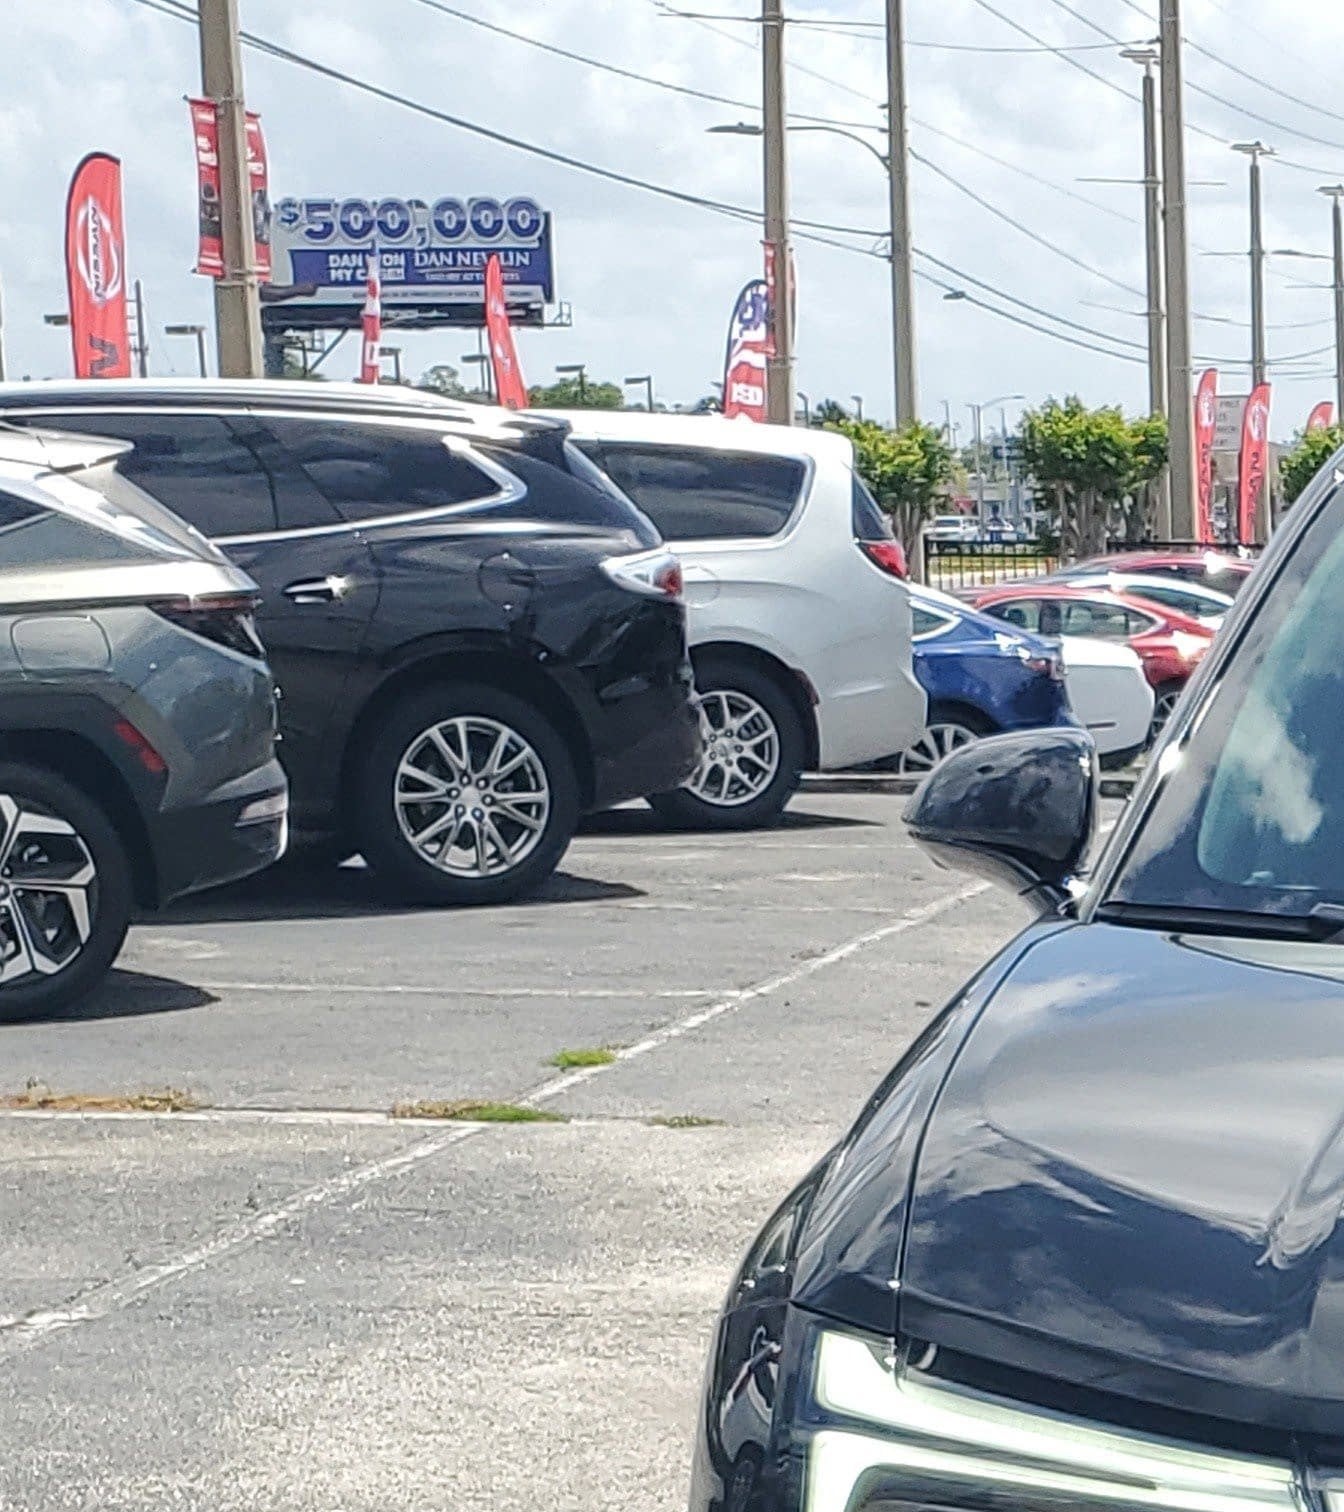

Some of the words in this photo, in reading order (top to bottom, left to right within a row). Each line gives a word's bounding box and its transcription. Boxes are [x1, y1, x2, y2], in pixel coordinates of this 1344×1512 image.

[279, 199, 544, 246] $500,000
[414, 251, 454, 267] DAN
[330, 268, 354, 281] MY
